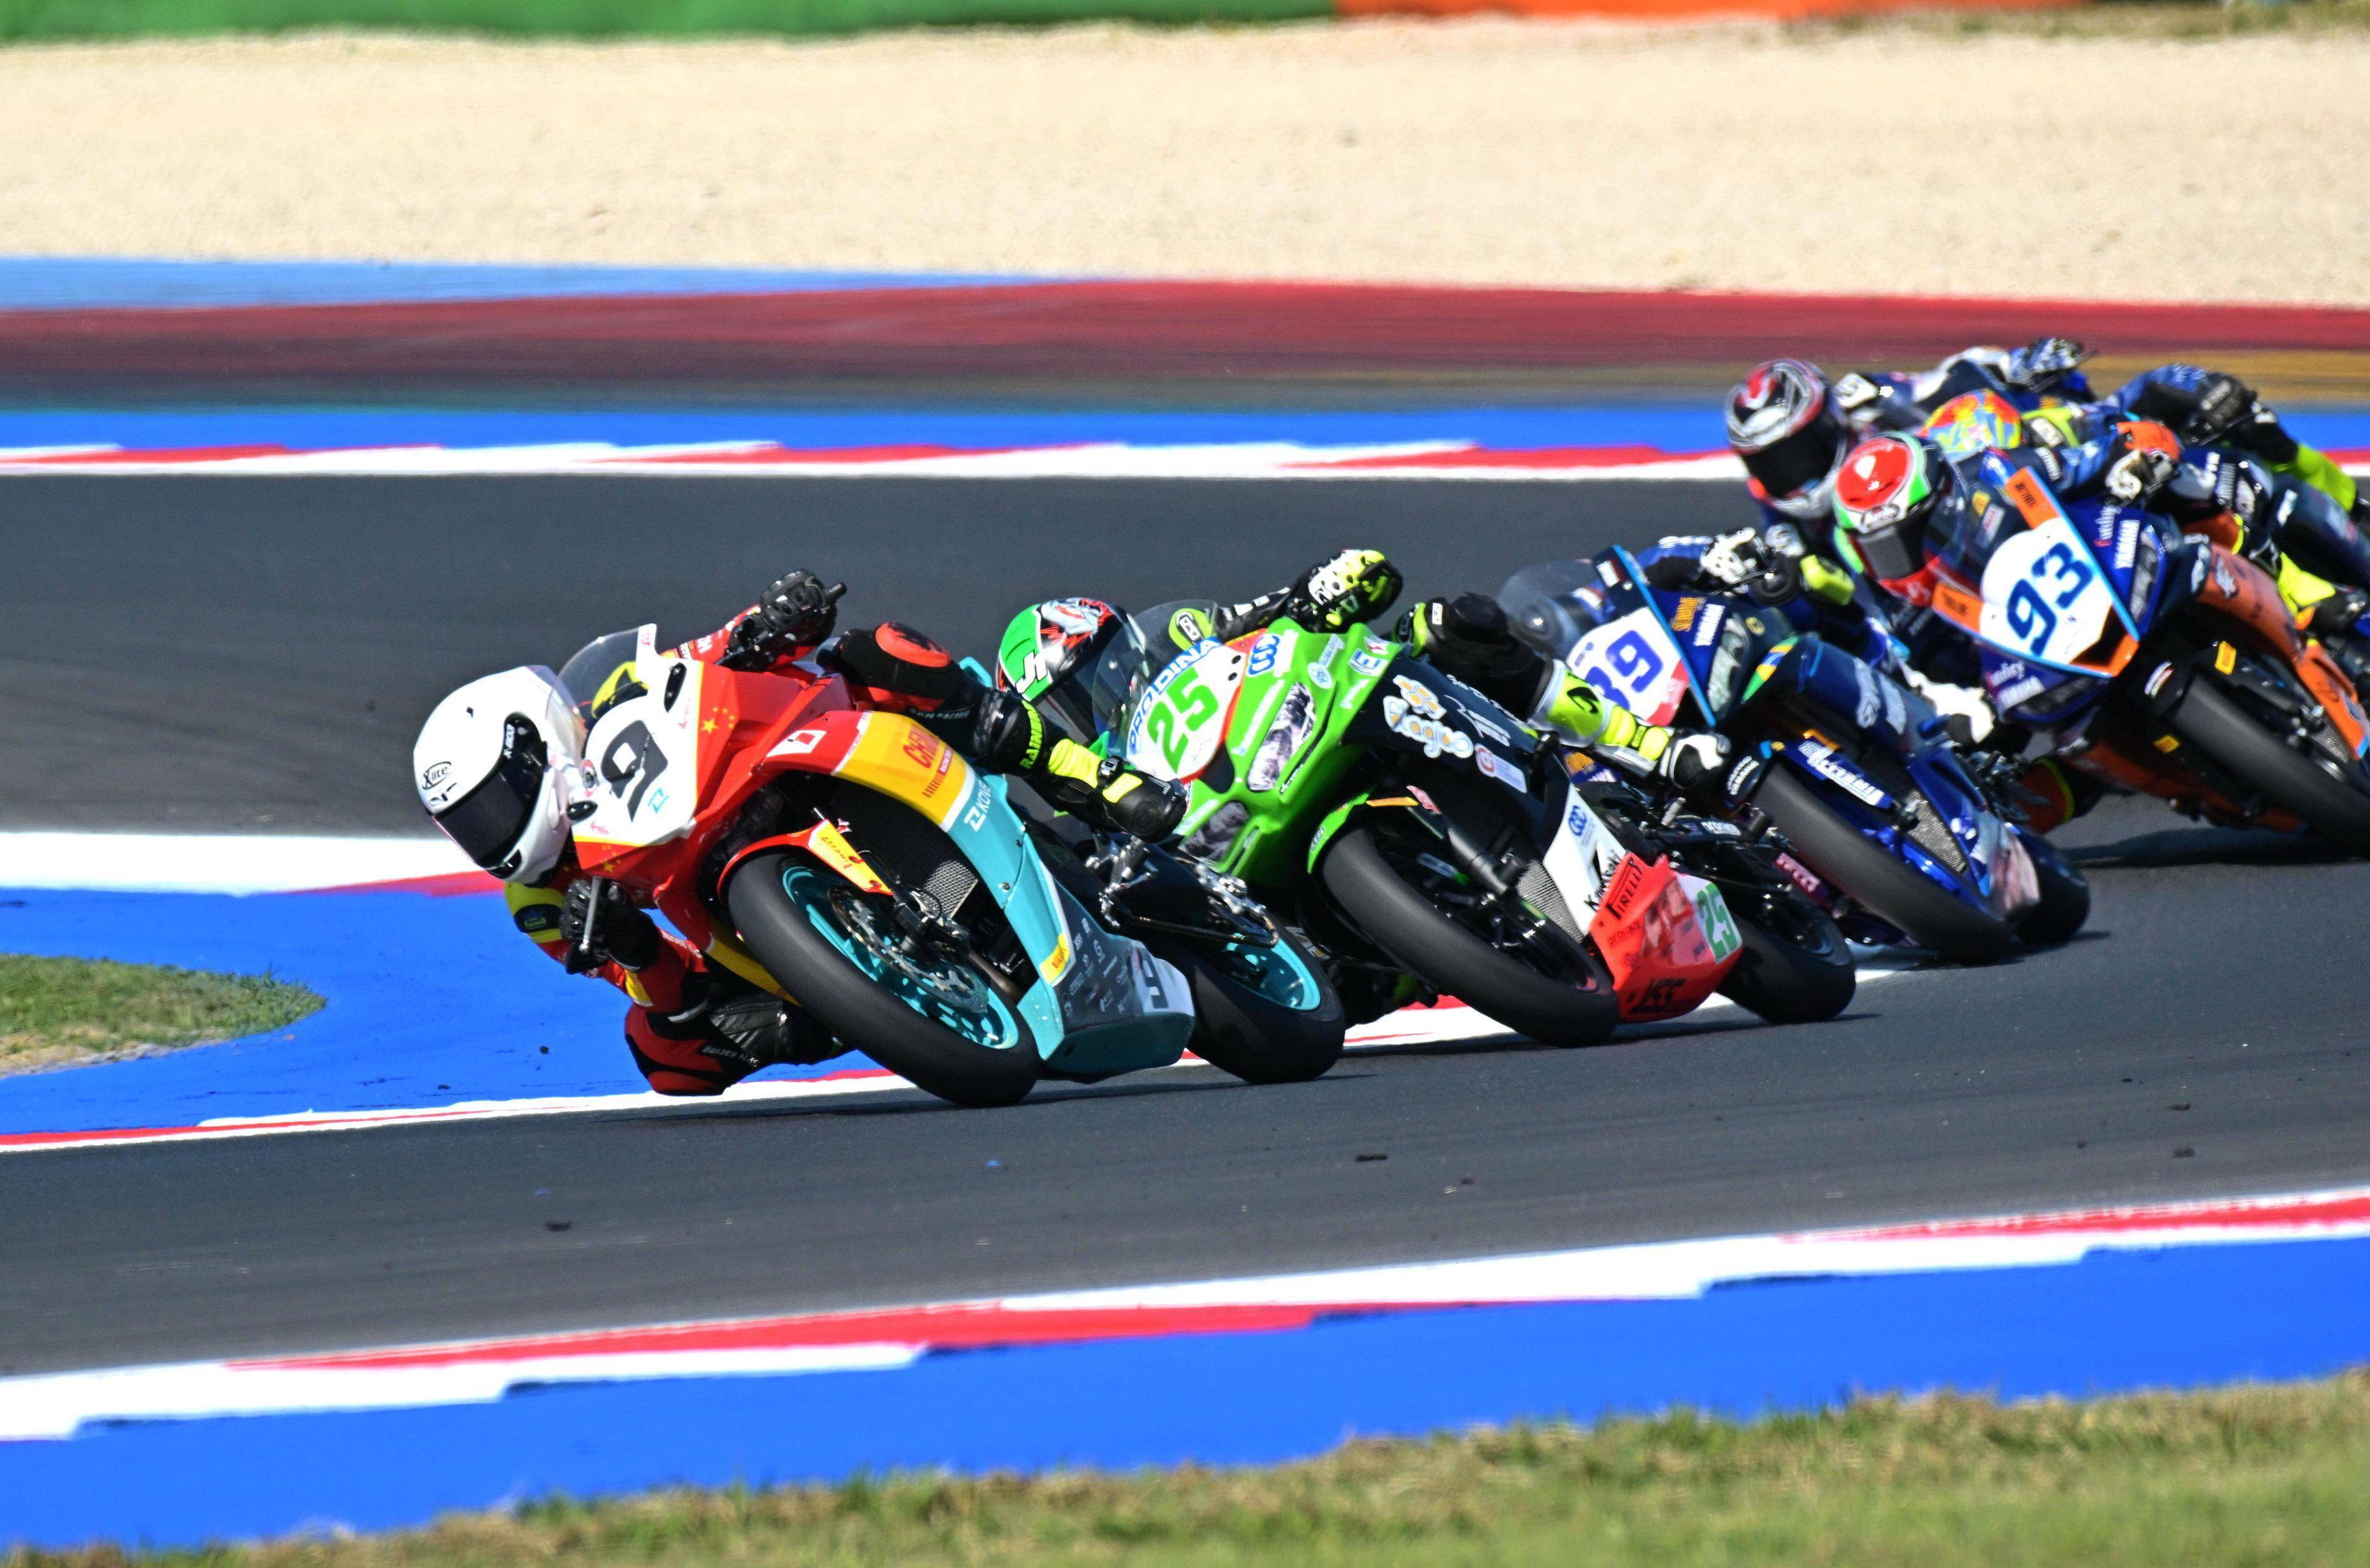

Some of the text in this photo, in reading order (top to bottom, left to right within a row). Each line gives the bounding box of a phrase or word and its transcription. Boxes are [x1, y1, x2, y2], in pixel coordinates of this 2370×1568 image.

[2007, 542, 2093, 657] 93
[600, 719, 669, 823] 9
[1147, 666, 1219, 775] 25
